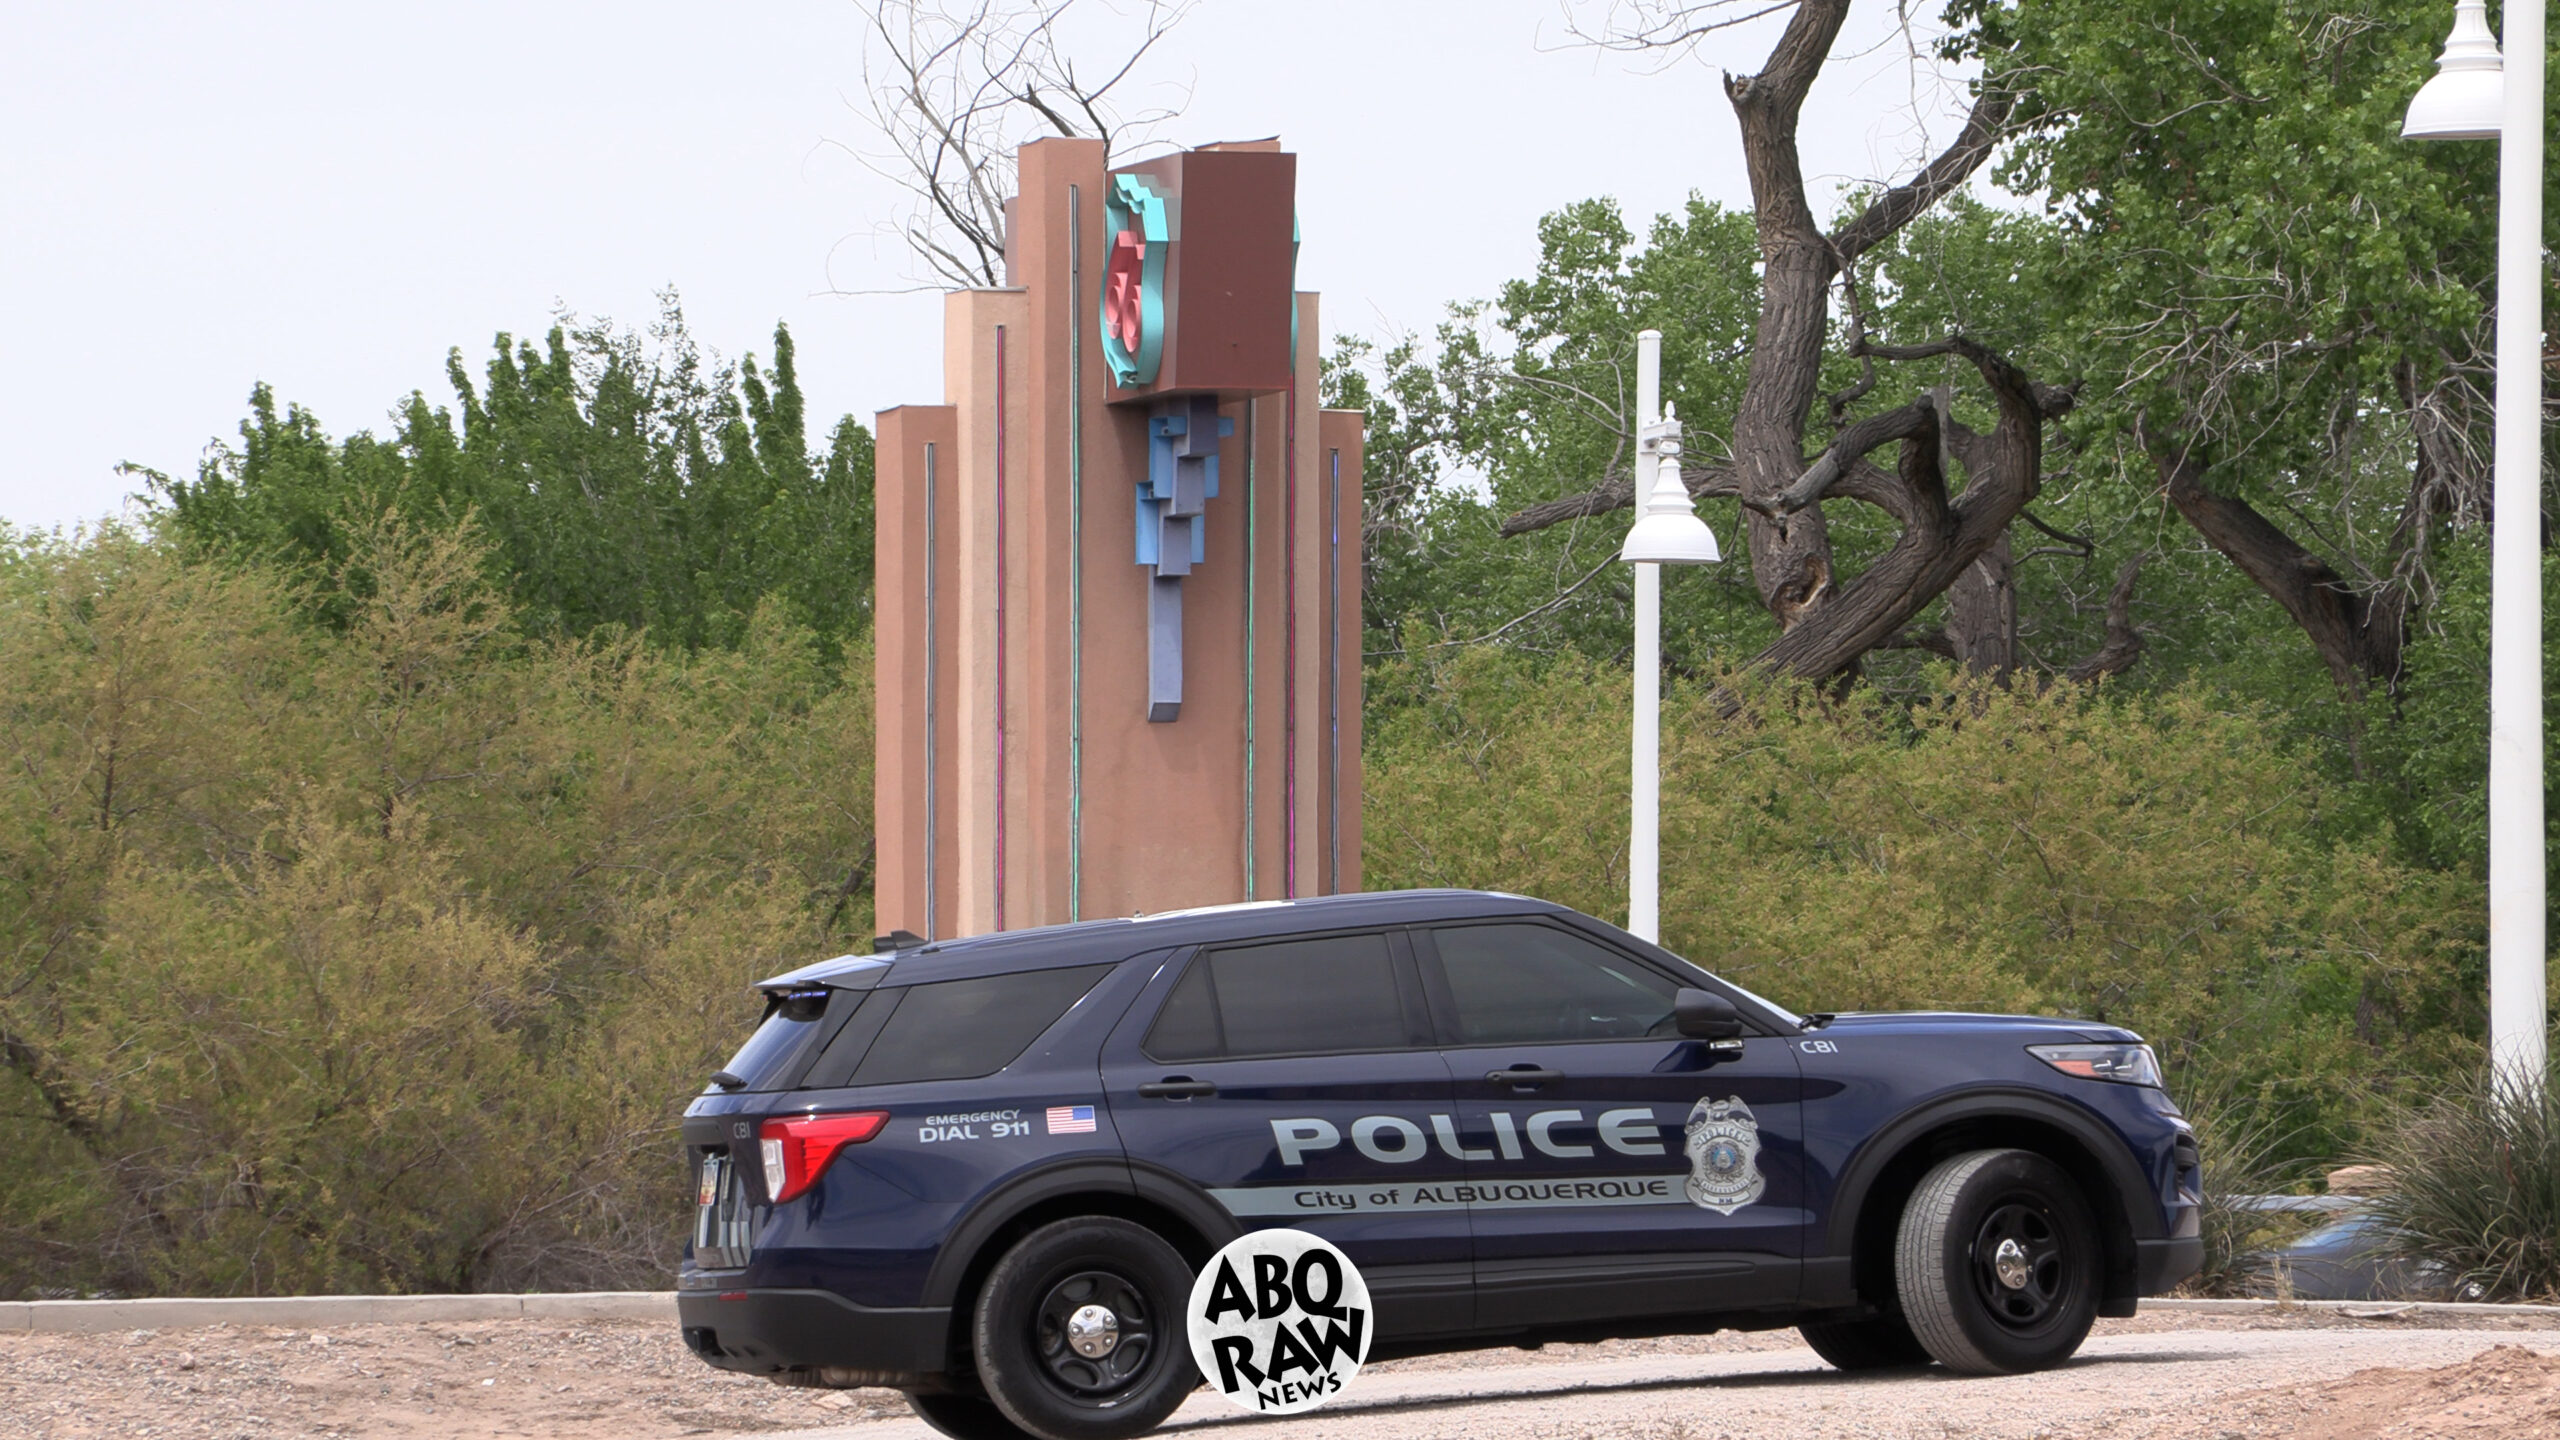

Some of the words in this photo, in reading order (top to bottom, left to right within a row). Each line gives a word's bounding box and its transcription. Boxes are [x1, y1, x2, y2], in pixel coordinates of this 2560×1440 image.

[925, 1109, 1020, 1125] EMERGENCY
[919, 1124, 980, 1143] DIAL
[990, 1120, 1030, 1138] 911
[1269, 1107, 1666, 1166] POLICE
[1702, 1127, 1742, 1142] POLICE
[1293, 1190, 1357, 1210] City
[1368, 1189, 1400, 1206] of
[1412, 1180, 1669, 1205] ALBUQUERQUE
